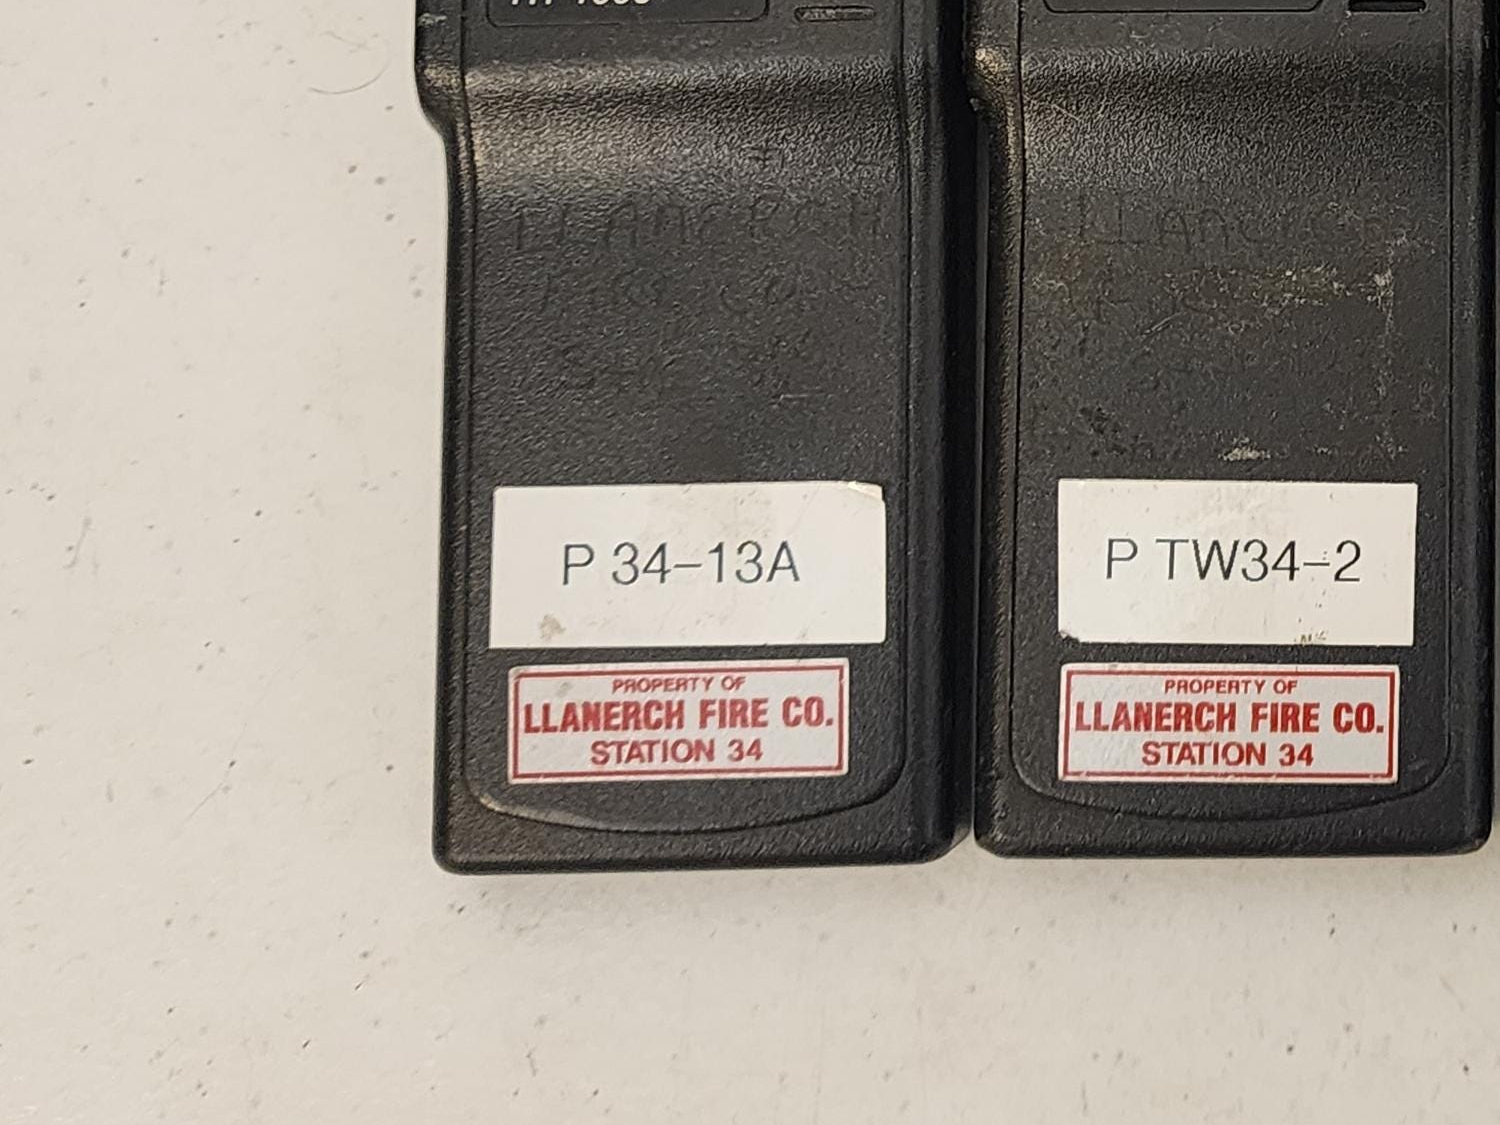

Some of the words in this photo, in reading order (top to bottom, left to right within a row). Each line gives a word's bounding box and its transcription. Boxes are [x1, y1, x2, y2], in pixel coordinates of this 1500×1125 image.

[563, 544, 594, 585] P
[612, 540, 800, 586] 34-13A
[1106, 538, 1138, 579] P
[1155, 538, 1361, 582] TW34-2
[612, 677, 712, 692] PROPERTY
[722, 675, 745, 691] OF
[1164, 679, 1266, 695] PROPERTY
[1272, 678, 1298, 694] OF
[523, 699, 685, 735] LLANERCH
[698, 698, 767, 729] FIRE
[781, 697, 834, 729] CO.
[1074, 700, 1238, 734] LLANERCH
[1250, 700, 1320, 735] FIRE
[1332, 701, 1384, 734] CO.
[591, 739, 715, 767] STATION
[727, 739, 764, 763] 34
[1142, 741, 1268, 768] STATION
[1279, 742, 1314, 768] 34
